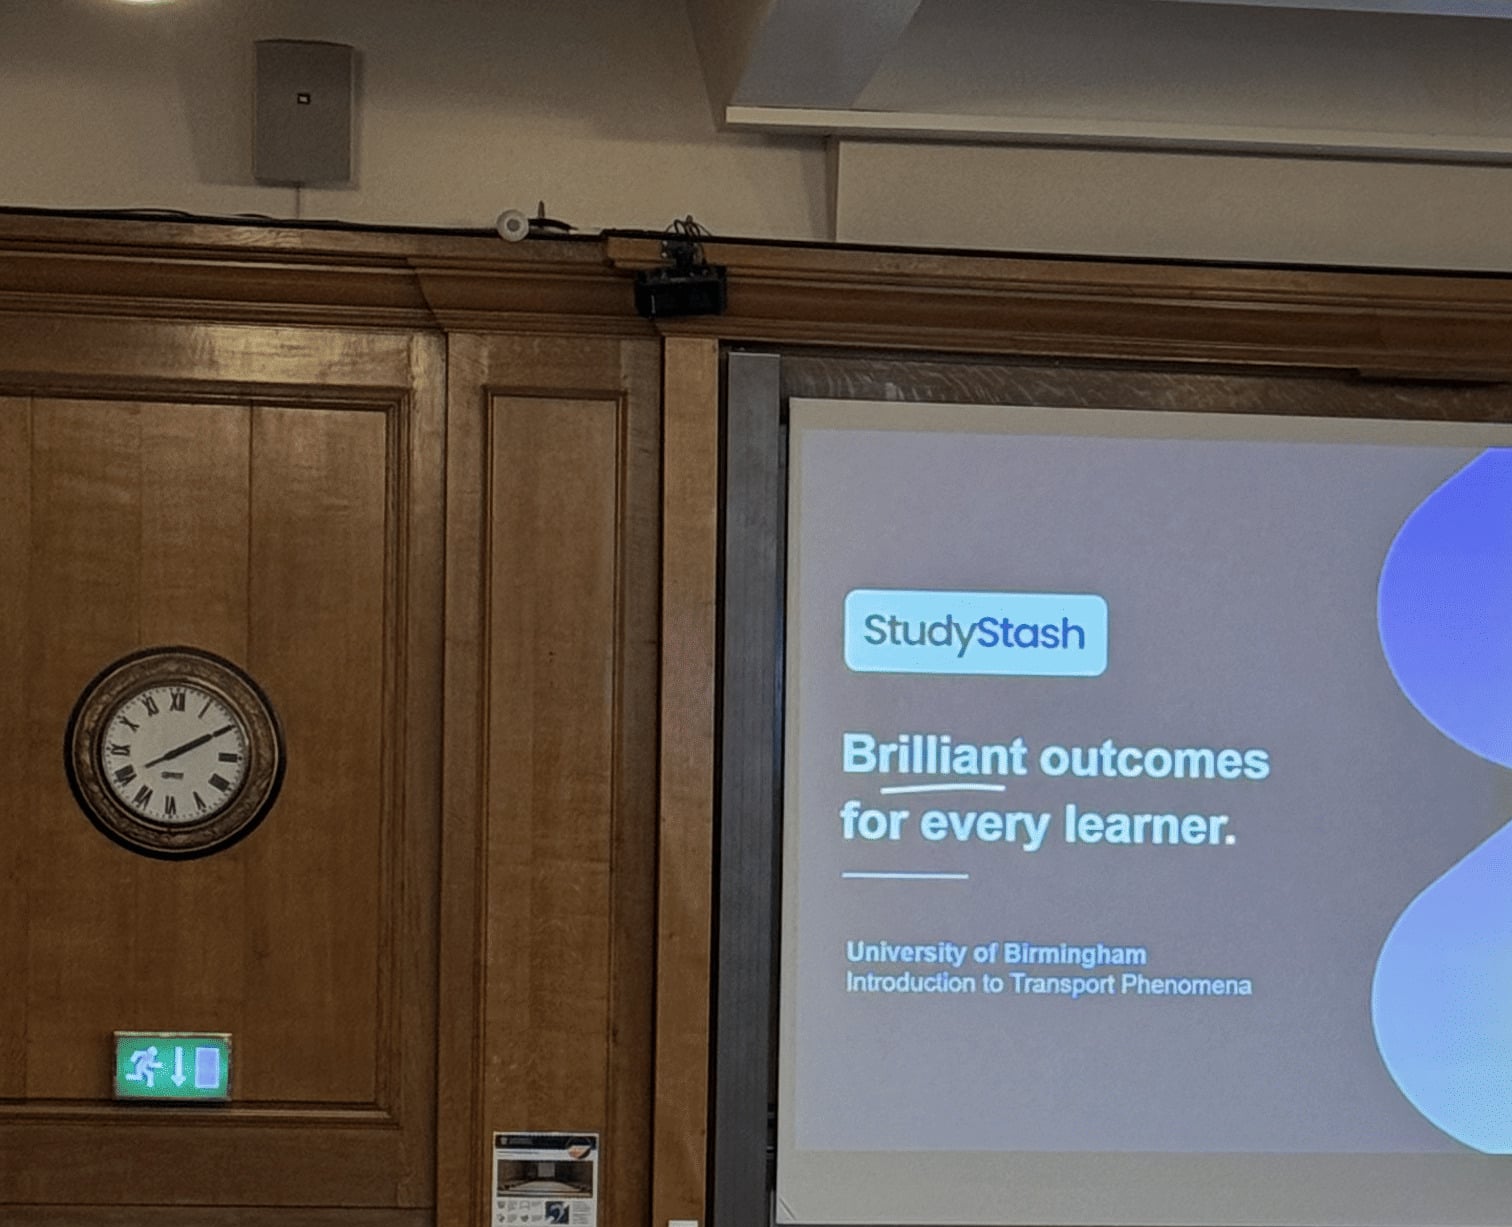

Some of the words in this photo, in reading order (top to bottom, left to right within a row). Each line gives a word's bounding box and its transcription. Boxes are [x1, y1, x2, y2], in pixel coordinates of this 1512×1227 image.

[863, 612, 1086, 658] StudyStash
[842, 732, 1028, 776] Brilliant
[1040, 739, 1271, 780] outcomes
[841, 801, 908, 840] for
[920, 807, 1051, 853] every
[1065, 804, 1237, 846] learner.
[847, 940, 968, 968] University
[973, 942, 999, 964] of
[1004, 942, 1147, 969] Birmingham
[846, 971, 976, 993] Introduction
[982, 973, 1004, 993] to
[1009, 972, 1116, 999] Transport
[1121, 973, 1253, 995] Phenomena
